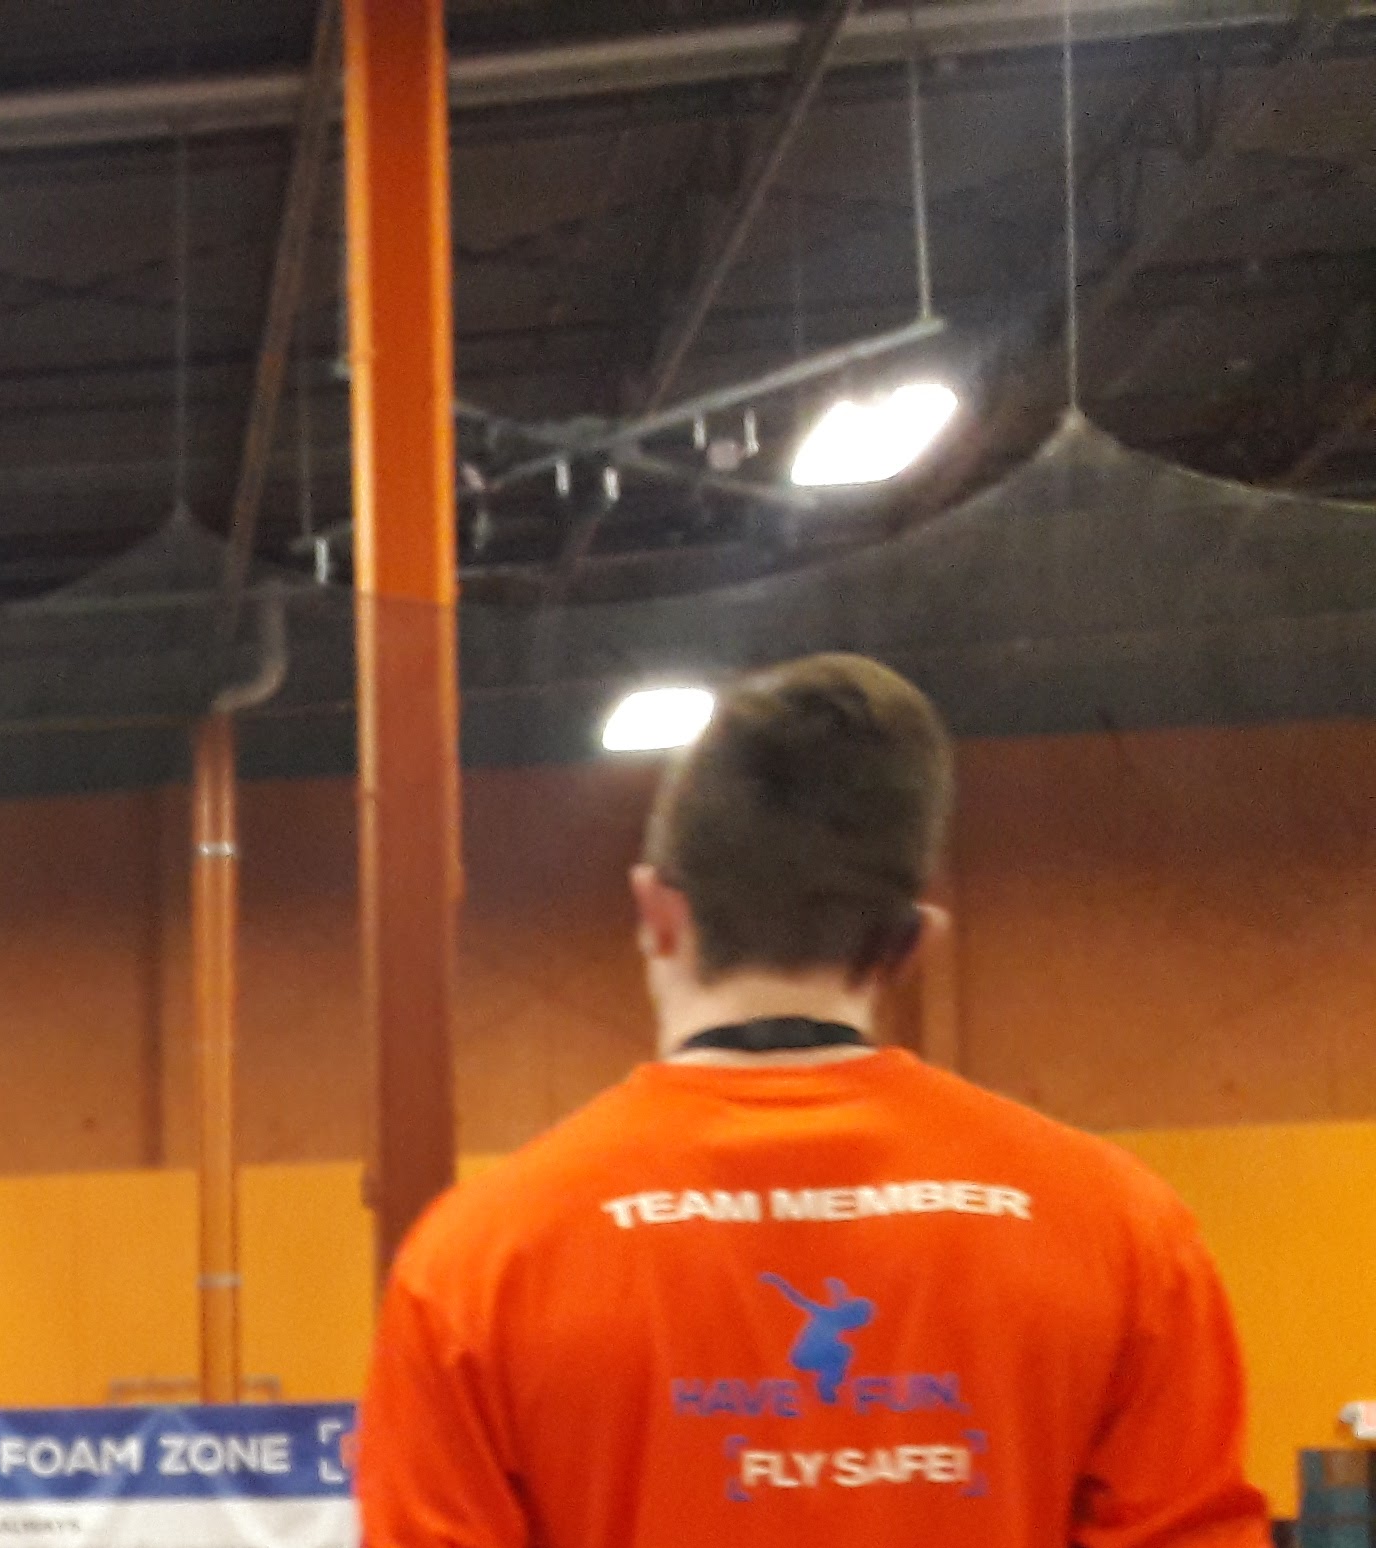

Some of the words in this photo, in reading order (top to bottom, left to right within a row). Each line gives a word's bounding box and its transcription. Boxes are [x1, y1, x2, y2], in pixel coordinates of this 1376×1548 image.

[601, 1188, 762, 1230] TEAM
[769, 1179, 1033, 1222] MEMBER
[671, 1375, 801, 1419] HAVE
[158, 1434, 291, 1477] ZONE
[742, 1449, 828, 1489] FLY
[832, 1444, 971, 1488] SAFE!
